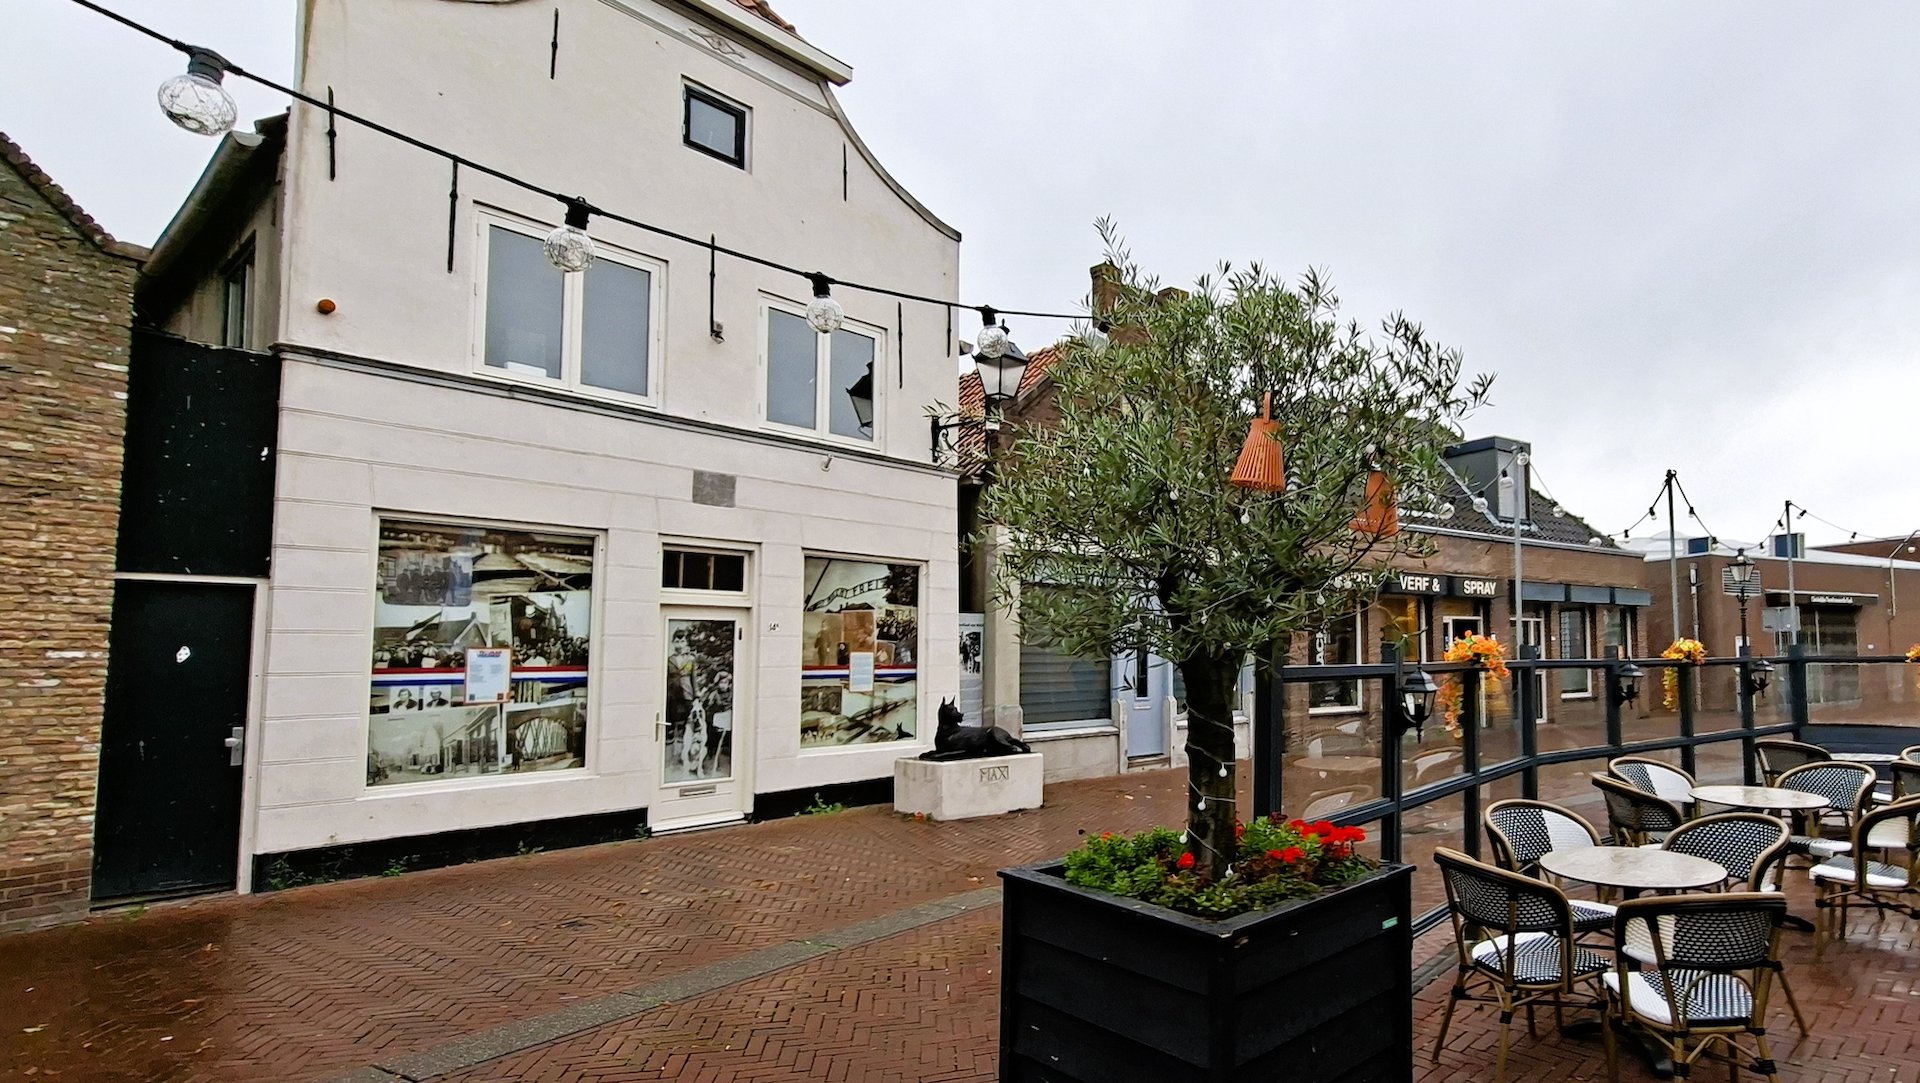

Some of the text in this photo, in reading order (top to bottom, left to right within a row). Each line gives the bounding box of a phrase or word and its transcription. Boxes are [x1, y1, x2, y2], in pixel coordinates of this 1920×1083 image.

[1399, 575, 1497, 595] VERF & SPRAY
